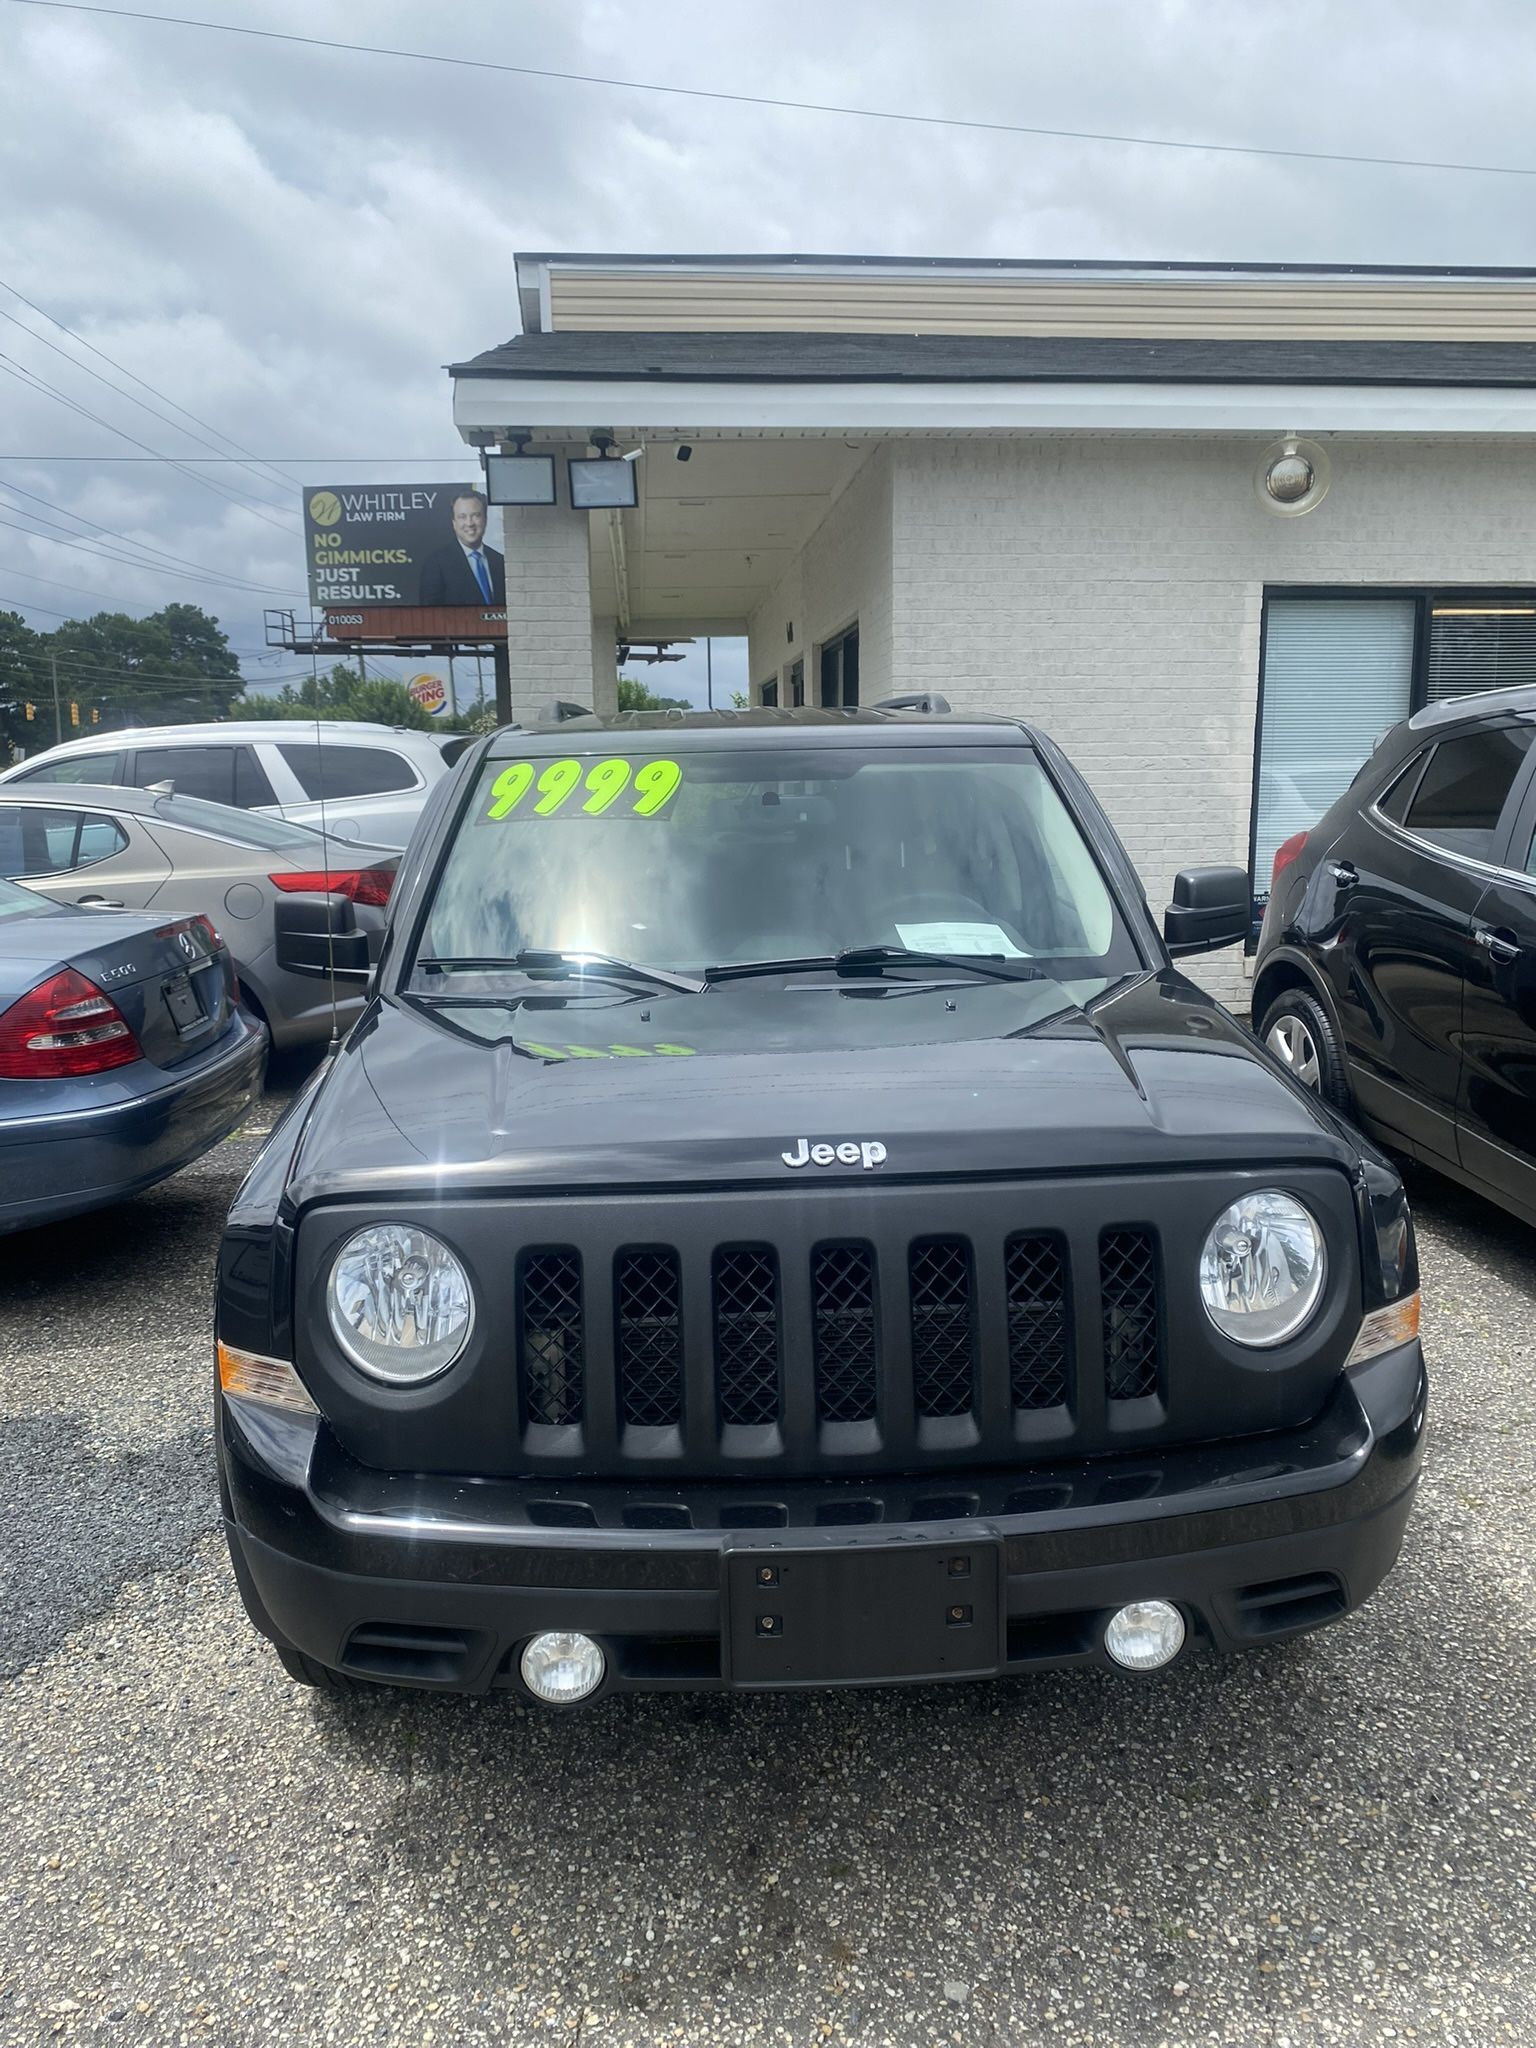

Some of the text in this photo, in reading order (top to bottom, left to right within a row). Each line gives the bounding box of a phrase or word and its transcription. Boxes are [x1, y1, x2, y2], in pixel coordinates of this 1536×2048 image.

[341, 492, 438, 511] WHITLEY
[346, 511, 405, 522] LAW FIRM
[313, 532, 342, 548] NO
[315, 549, 413, 565] GIMMICKS.
[316, 567, 361, 582] JUST
[317, 584, 402, 600] RESULTS.
[484, 612, 507, 620] LAM
[409, 680, 443, 697] BURGER
[487, 758, 683, 821] 9999
[100, 963, 137, 982] E500
[781, 1138, 887, 1170] Jeep
